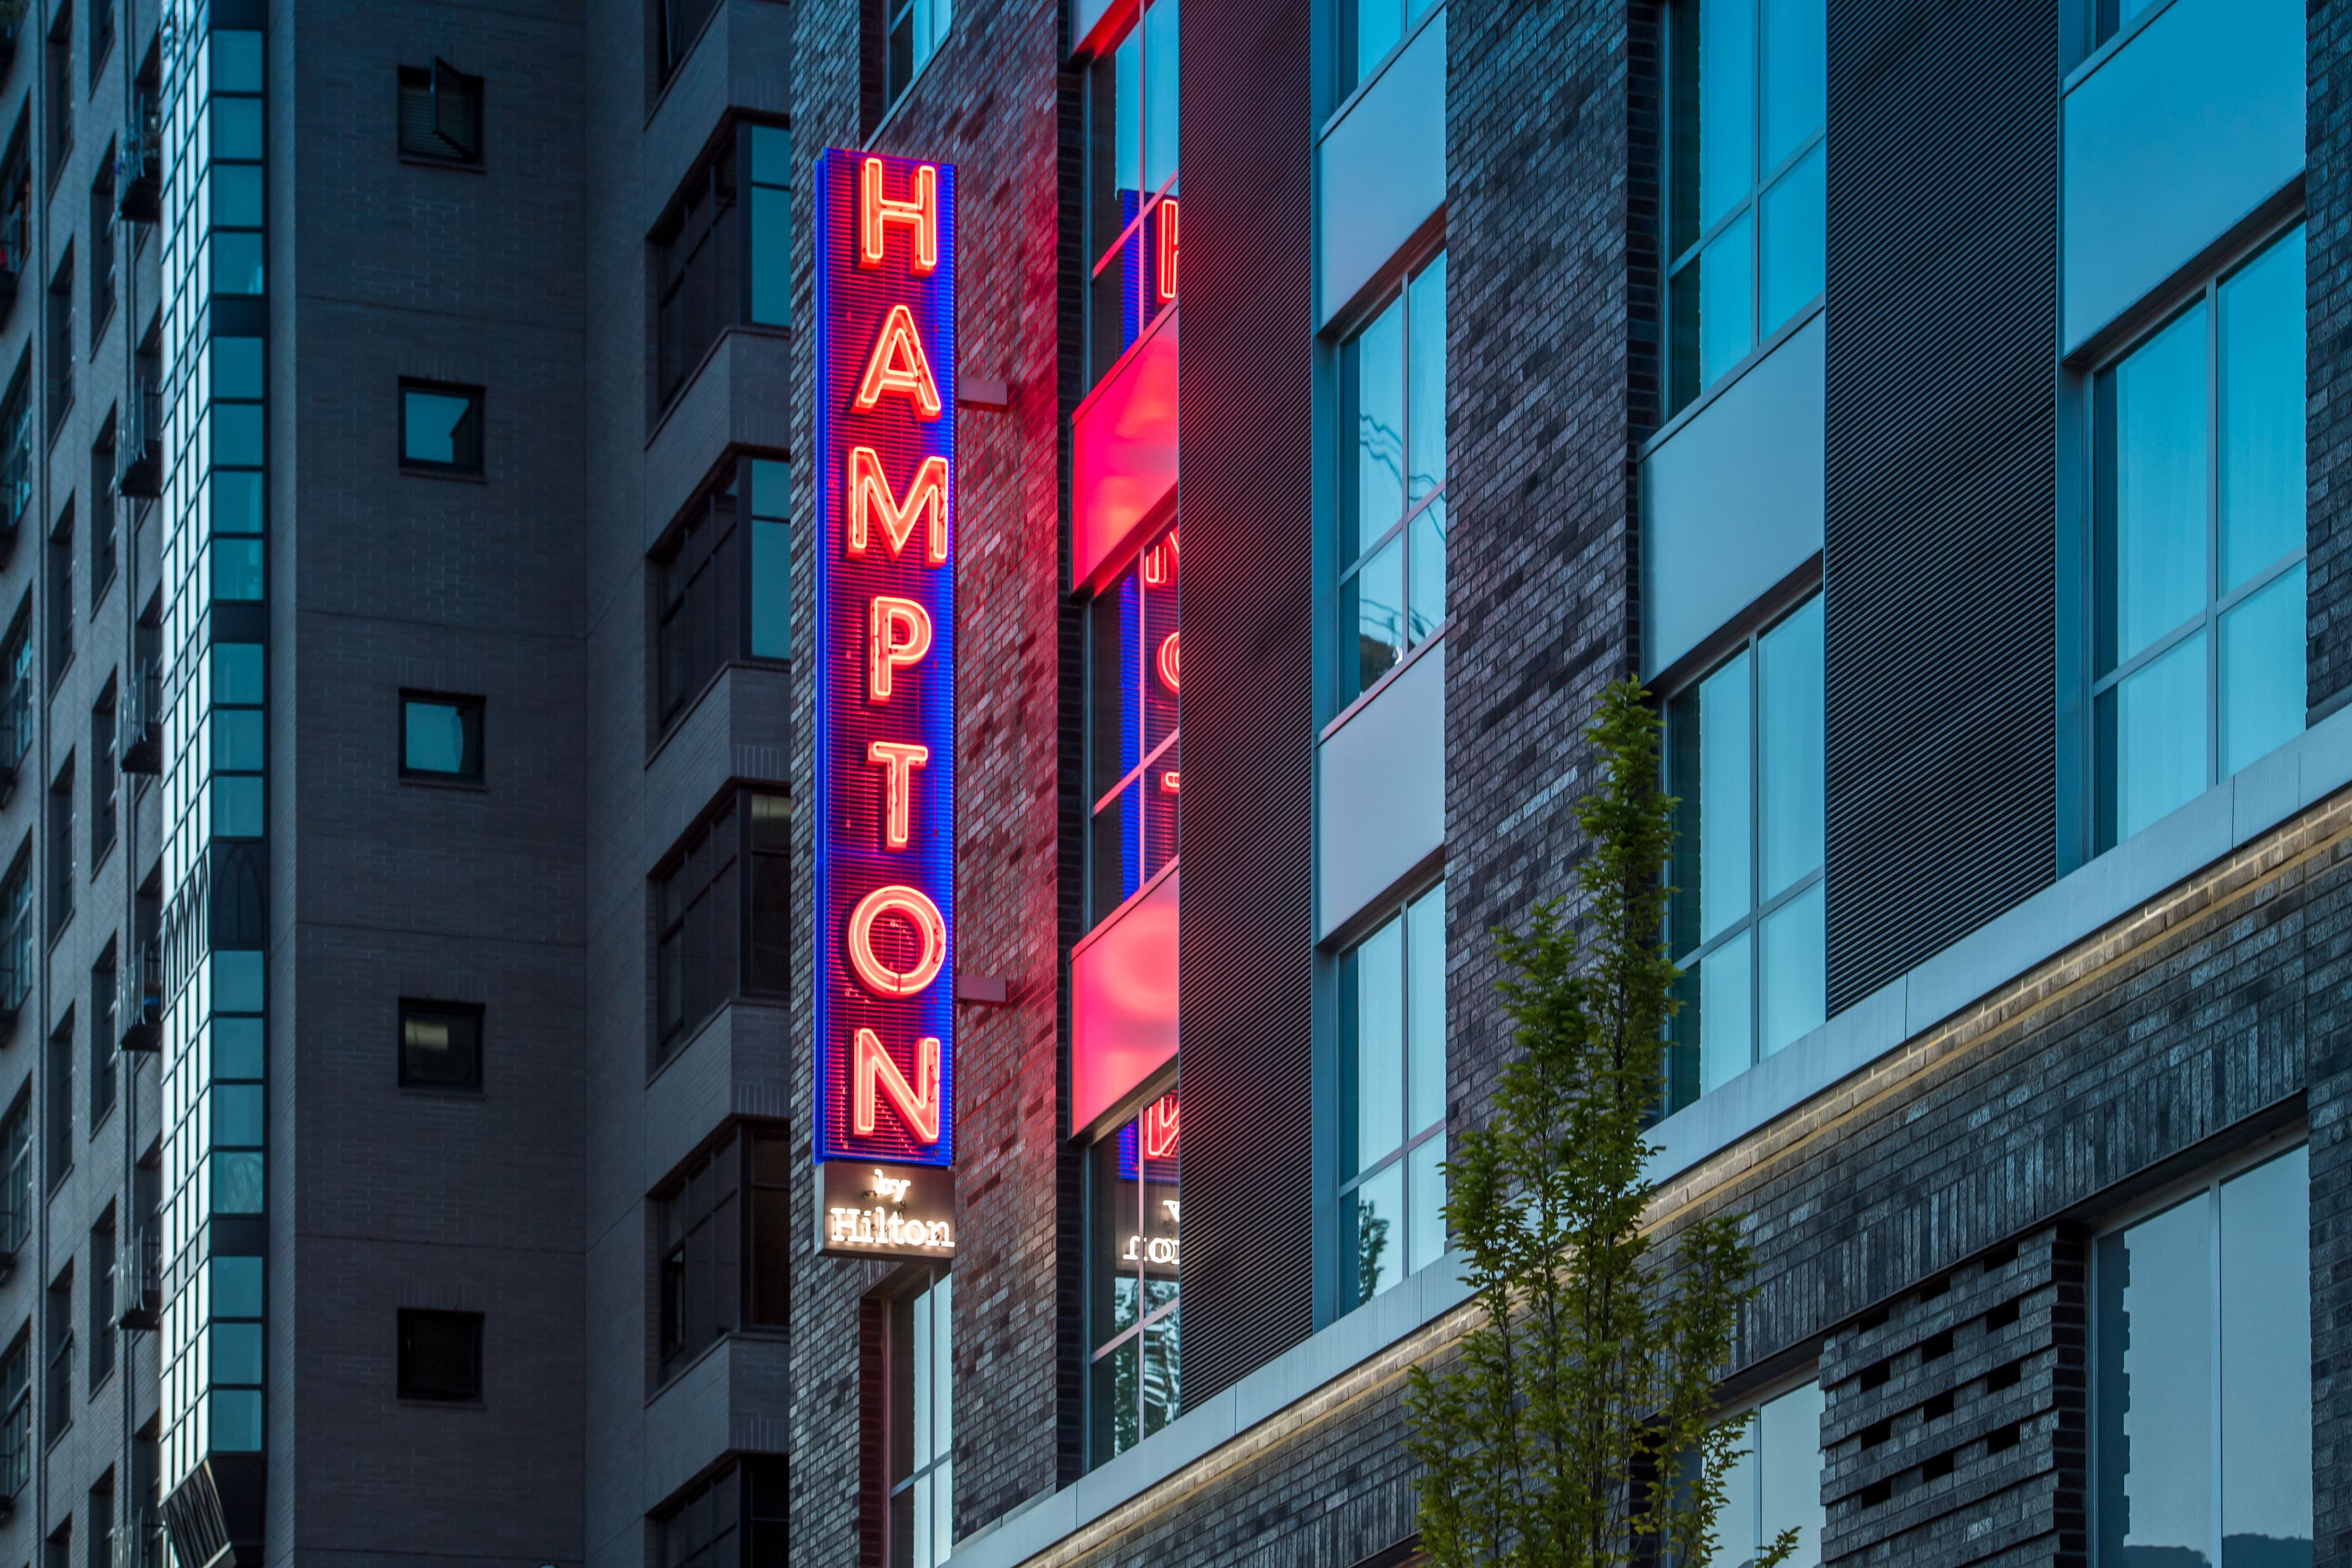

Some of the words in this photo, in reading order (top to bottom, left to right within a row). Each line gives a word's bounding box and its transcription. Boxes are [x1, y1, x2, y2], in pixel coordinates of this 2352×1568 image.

[847, 157, 949, 1145] HAMPTON
[874, 1168, 911, 1202] by
[830, 1206, 955, 1248] Hilton
